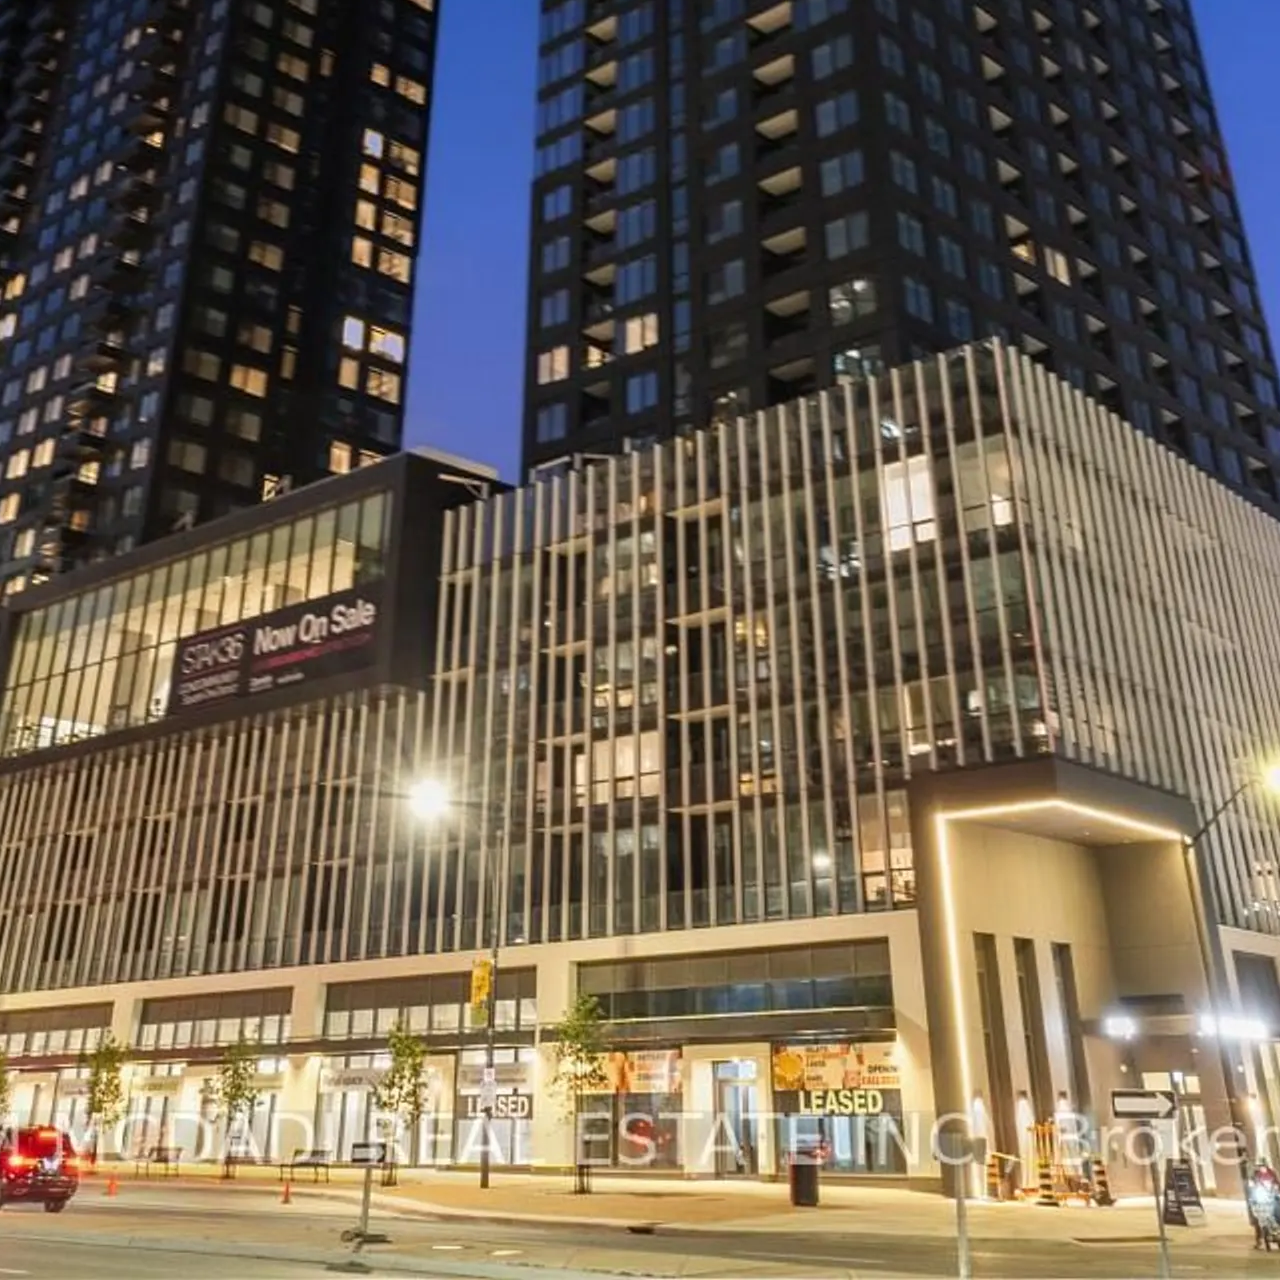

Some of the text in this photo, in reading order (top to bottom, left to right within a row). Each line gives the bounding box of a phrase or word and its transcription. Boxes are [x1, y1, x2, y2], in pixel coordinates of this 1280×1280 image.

[253, 599, 377, 655] Now On Sale
[467, 1095, 529, 1117] LESED
[799, 1089, 883, 1115] LEASED
